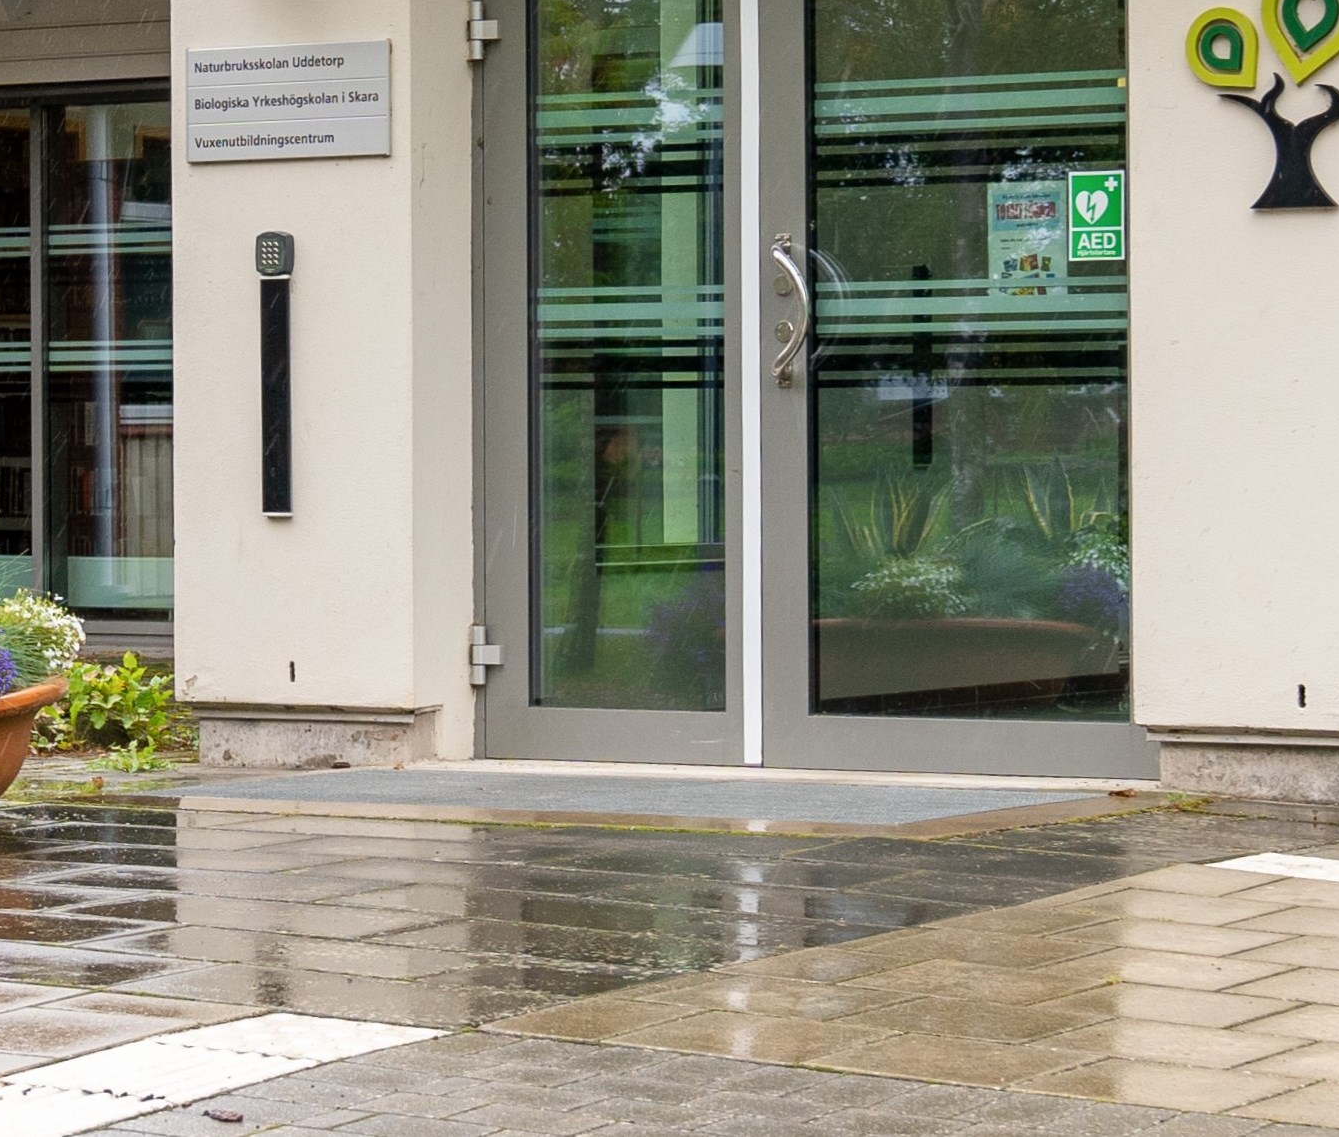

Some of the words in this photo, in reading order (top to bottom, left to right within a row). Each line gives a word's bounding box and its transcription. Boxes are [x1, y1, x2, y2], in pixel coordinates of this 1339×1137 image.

[194, 58, 289, 73] Naturbruksskolan
[292, 55, 344, 69] Uddetorp
[194, 96, 249, 111] Biologiska
[252, 90, 338, 108] Yrkeshögskolan
[341, 91, 346, 103] i
[348, 90, 379, 103] Skara
[194, 134, 335, 149] Vuxenutbildningscentrum
[1077, 232, 1117, 250] AED
